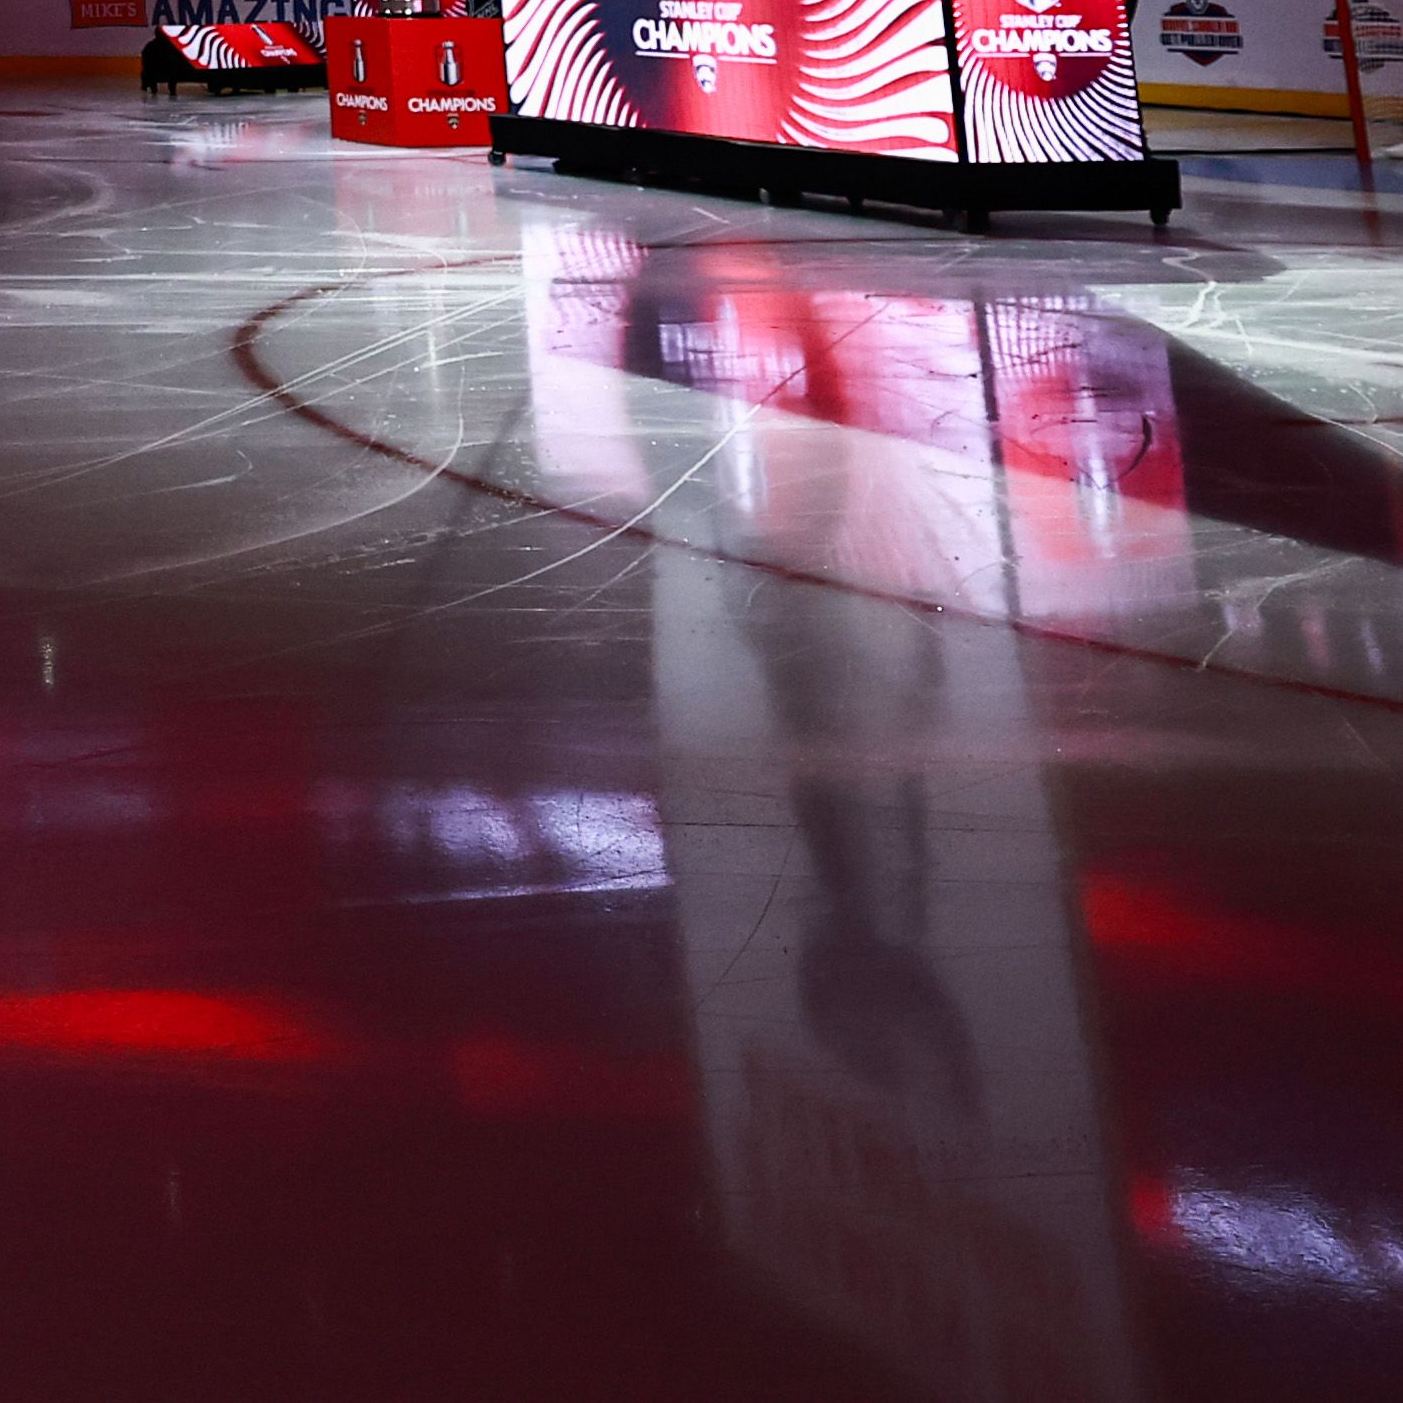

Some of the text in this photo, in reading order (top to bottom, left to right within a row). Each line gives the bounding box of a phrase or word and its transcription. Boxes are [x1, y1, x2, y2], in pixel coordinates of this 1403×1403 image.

[80, 1, 139, 19] MIKE'S
[659, 0, 743, 21] STANLEY CUP
[999, 14, 1055, 28] STANLEY
[632, 18, 778, 57] CHAMPIONS
[972, 29, 1113, 52] CHAMPIONS
[336, 92, 389, 112] CHAMPIONS
[407, 97, 496, 113] CHAMPIONS
